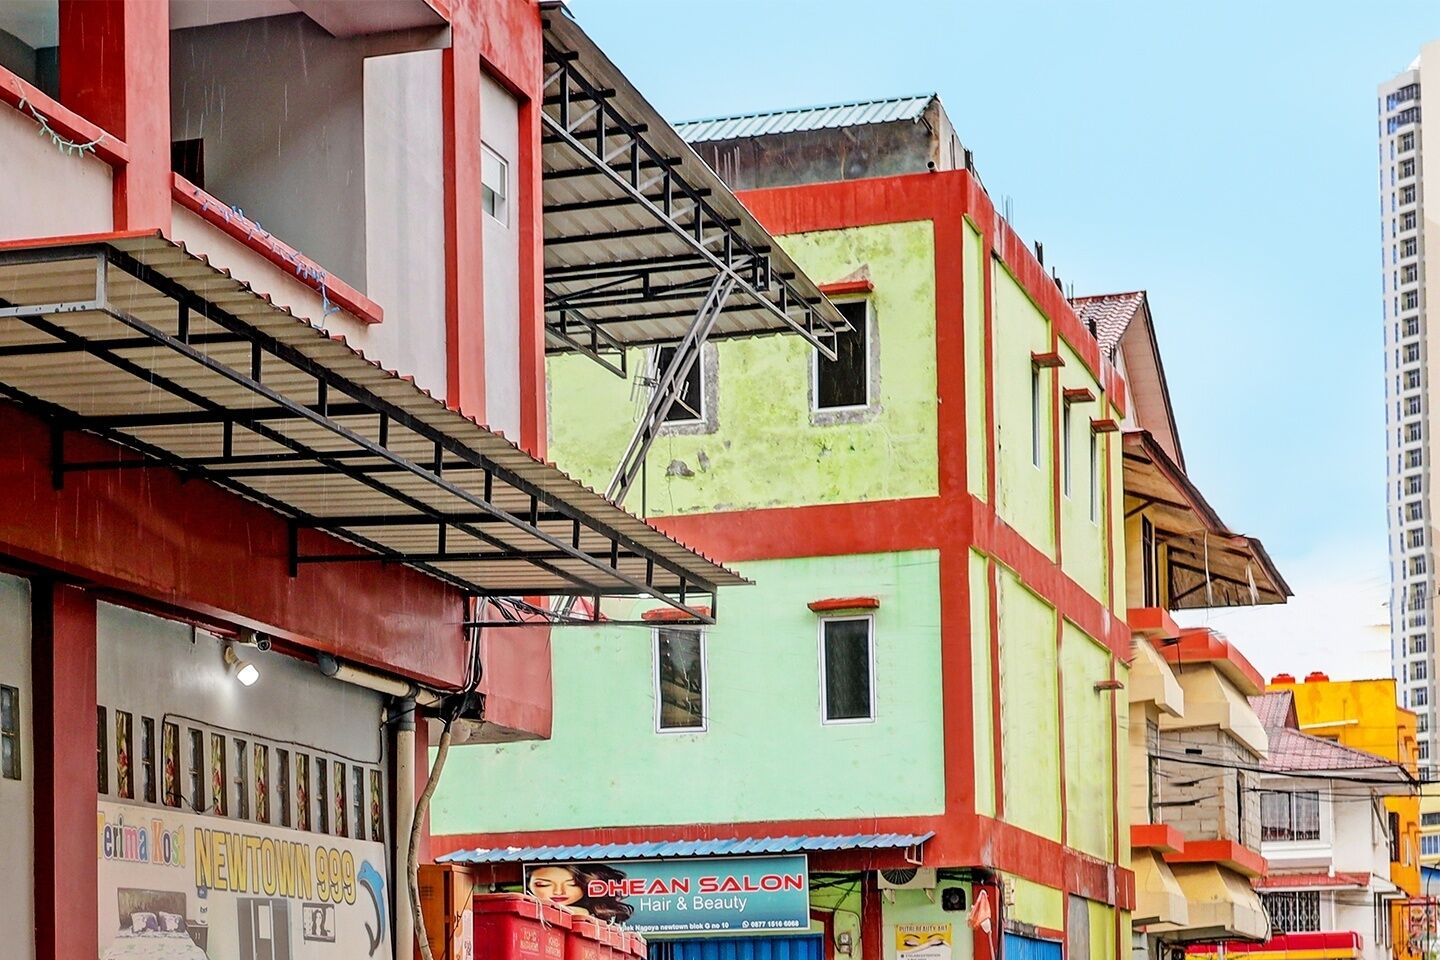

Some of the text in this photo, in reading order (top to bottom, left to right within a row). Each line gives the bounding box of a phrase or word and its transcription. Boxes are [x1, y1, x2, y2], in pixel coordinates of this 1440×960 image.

[152, 818, 186, 867] Kost
[194, 827, 356, 905] NEWTOWN 999
[587, 874, 804, 897] DHEAN SALON
[640, 895, 747, 912] Hair & Beauty
[635, 924, 659, 932] Nagoya
[660, 923, 688, 931] newtown
[689, 922, 703, 930] blok
